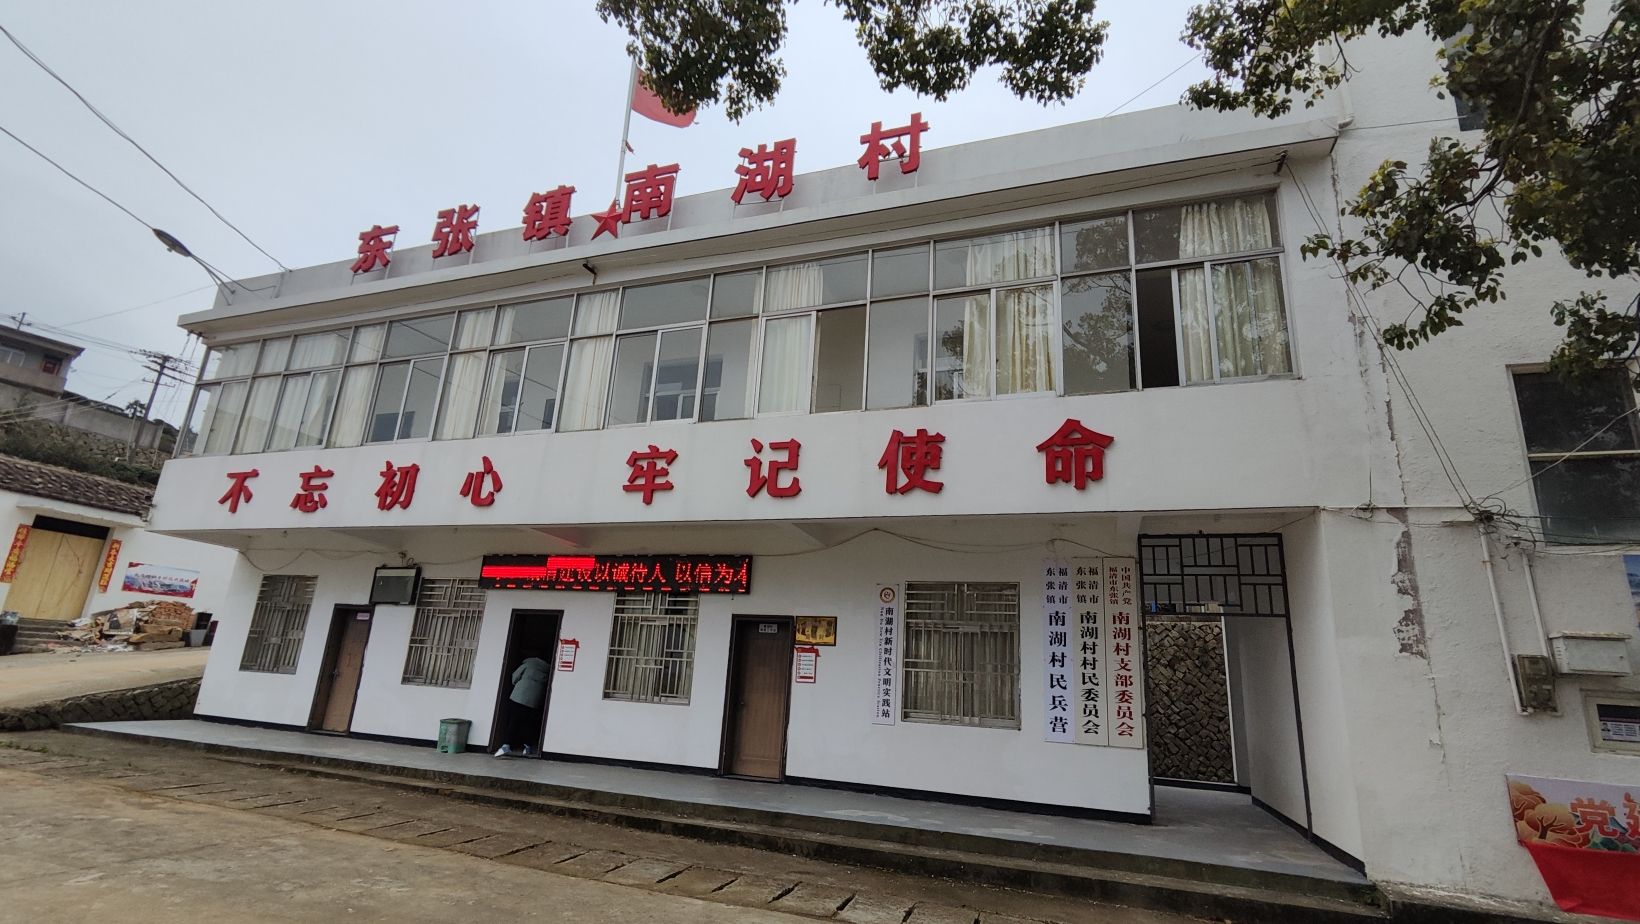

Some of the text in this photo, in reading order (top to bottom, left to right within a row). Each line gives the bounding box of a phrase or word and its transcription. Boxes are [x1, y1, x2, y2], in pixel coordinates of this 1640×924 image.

[351, 112, 930, 275] 东张镇南湖村
[218, 418, 1115, 514] 不忘初心 牢记使命
[1045, 567, 1056, 605] 东张镇
[1058, 567, 1068, 605] 福清市
[1075, 566, 1087, 604] 东张镇
[1088, 566, 1099, 605] 福清市
[1108, 566, 1119, 606] 福清市东张镇
[1121, 566, 1132, 606] 中国共产党
[881, 606, 894, 719] 南湖村新时代文明实践站
[1048, 610, 1069, 734] 南湖村民兵营
[1080, 610, 1100, 735] 南湖村村民委员会
[1112, 611, 1135, 737] 南湖村支部委员会
